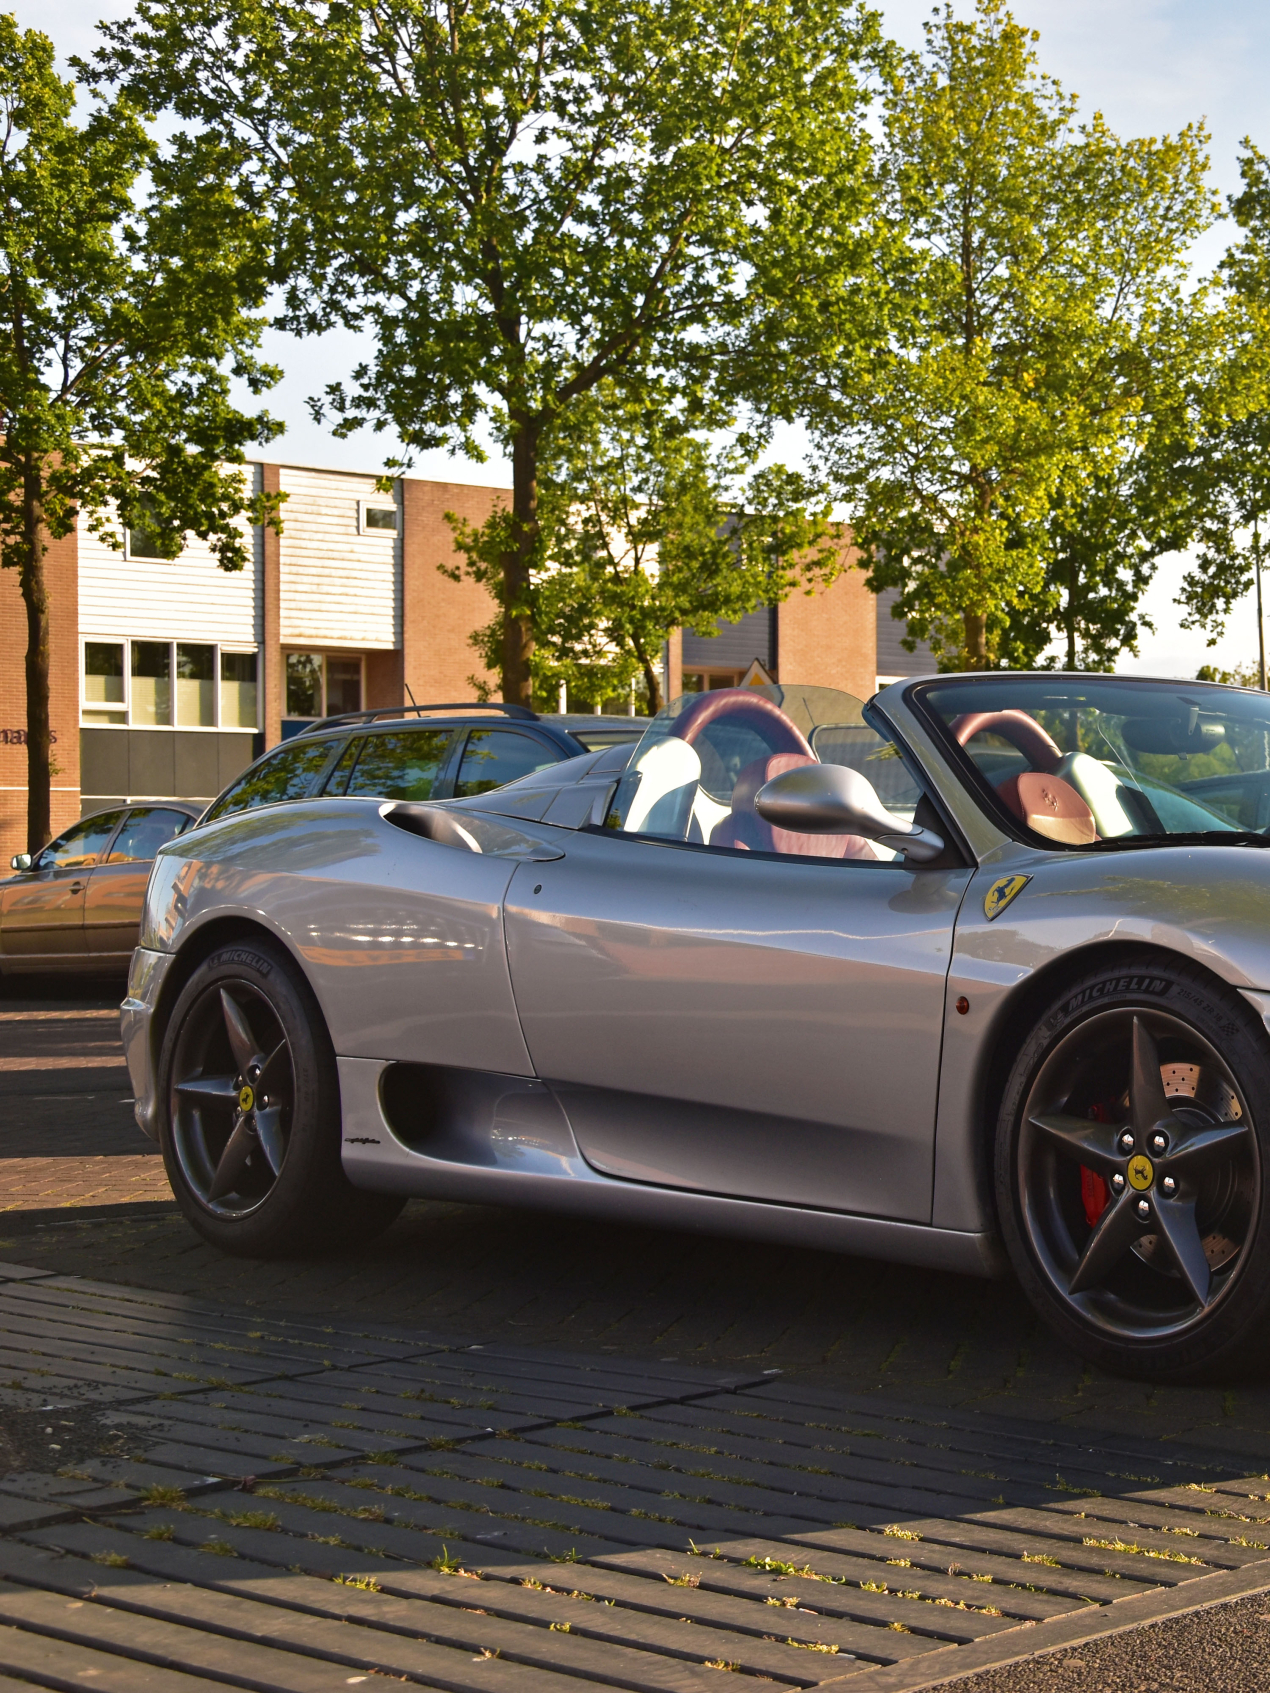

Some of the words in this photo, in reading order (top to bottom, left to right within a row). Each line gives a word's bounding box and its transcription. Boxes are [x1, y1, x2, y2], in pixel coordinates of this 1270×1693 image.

[220, 950, 271, 974] MICHELIN
[1068, 977, 1166, 1011] MICHELIN
[1177, 988, 1204, 1007] 215/45
[1202, 1003, 1215, 1015] ZR
